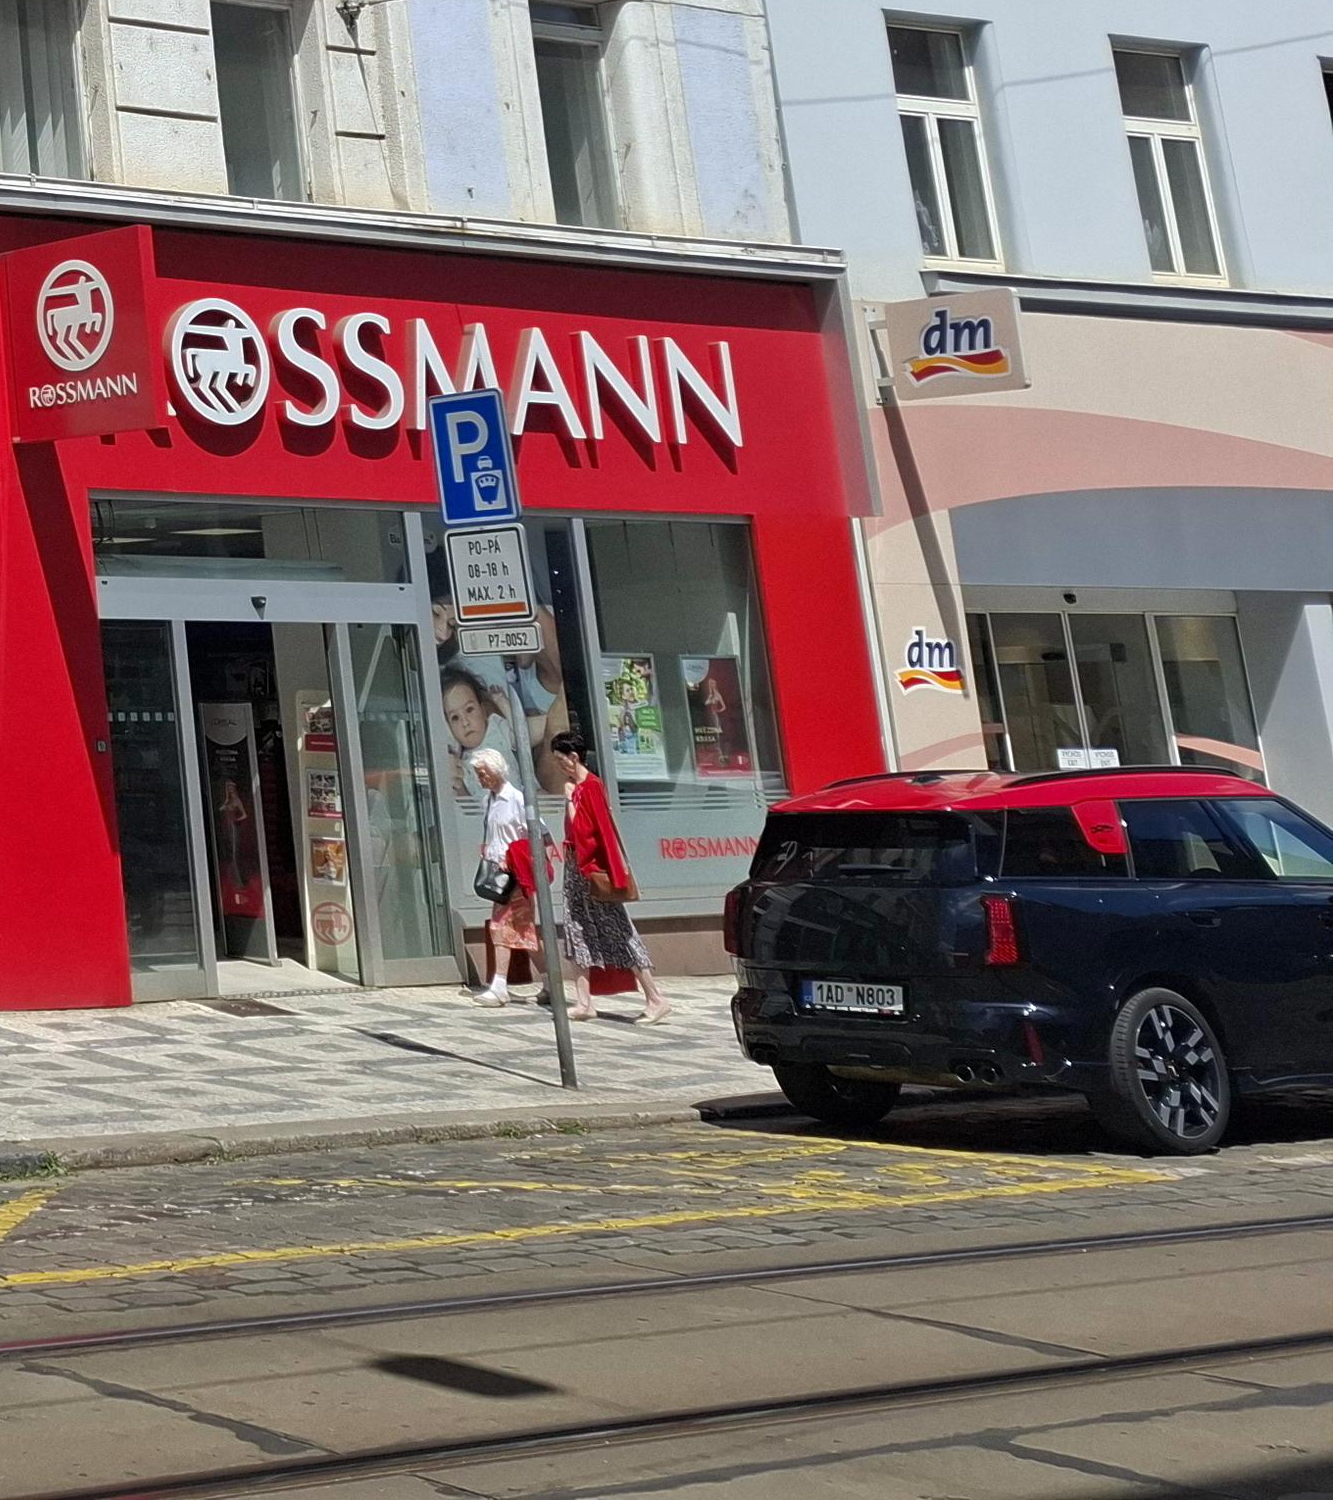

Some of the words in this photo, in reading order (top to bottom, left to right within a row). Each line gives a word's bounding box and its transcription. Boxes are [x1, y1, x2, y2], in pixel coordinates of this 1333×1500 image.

[923, 310, 994, 357] dm
[29, 372, 138, 409] ROSSMANN
[445, 410, 490, 483] P
[468, 535, 501, 555] PO-PÁ
[468, 563, 498, 578] 08-18
[502, 562, 509, 575] h
[468, 585, 494, 602] MAX.
[498, 586, 506, 599] 2
[509, 585, 517, 598] h
[488, 633, 529, 648] P7-0052
[907, 631, 955, 669] dm
[817, 983, 845, 1003] 1AD
[855, 986, 895, 1006] N803
